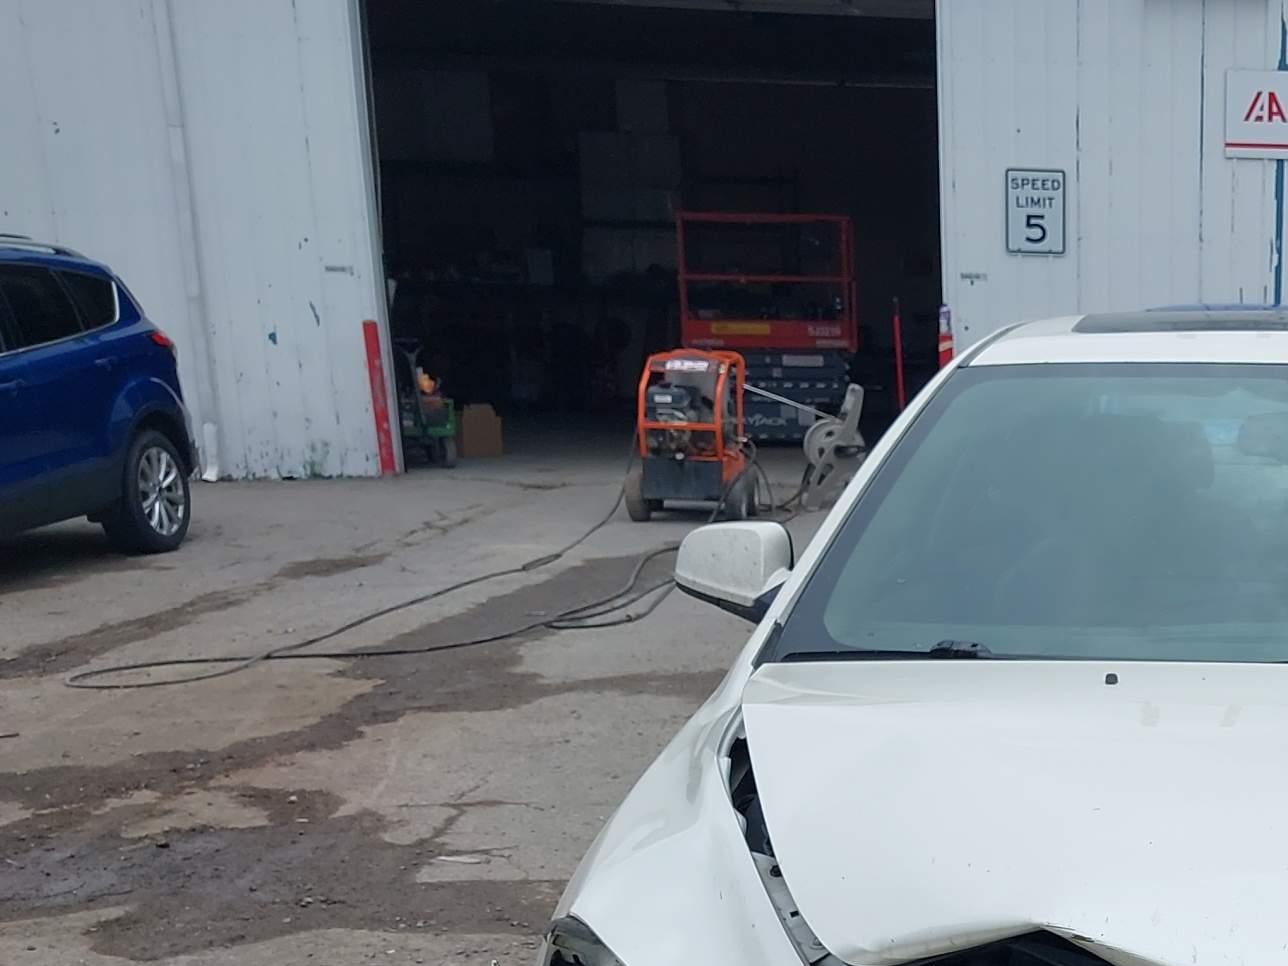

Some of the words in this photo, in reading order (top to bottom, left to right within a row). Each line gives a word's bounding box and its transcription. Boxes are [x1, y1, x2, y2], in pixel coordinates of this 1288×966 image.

[1010, 178, 1061, 191] SPEED
[1016, 196, 1055, 208] LIMIT
[1025, 214, 1046, 244] 5
